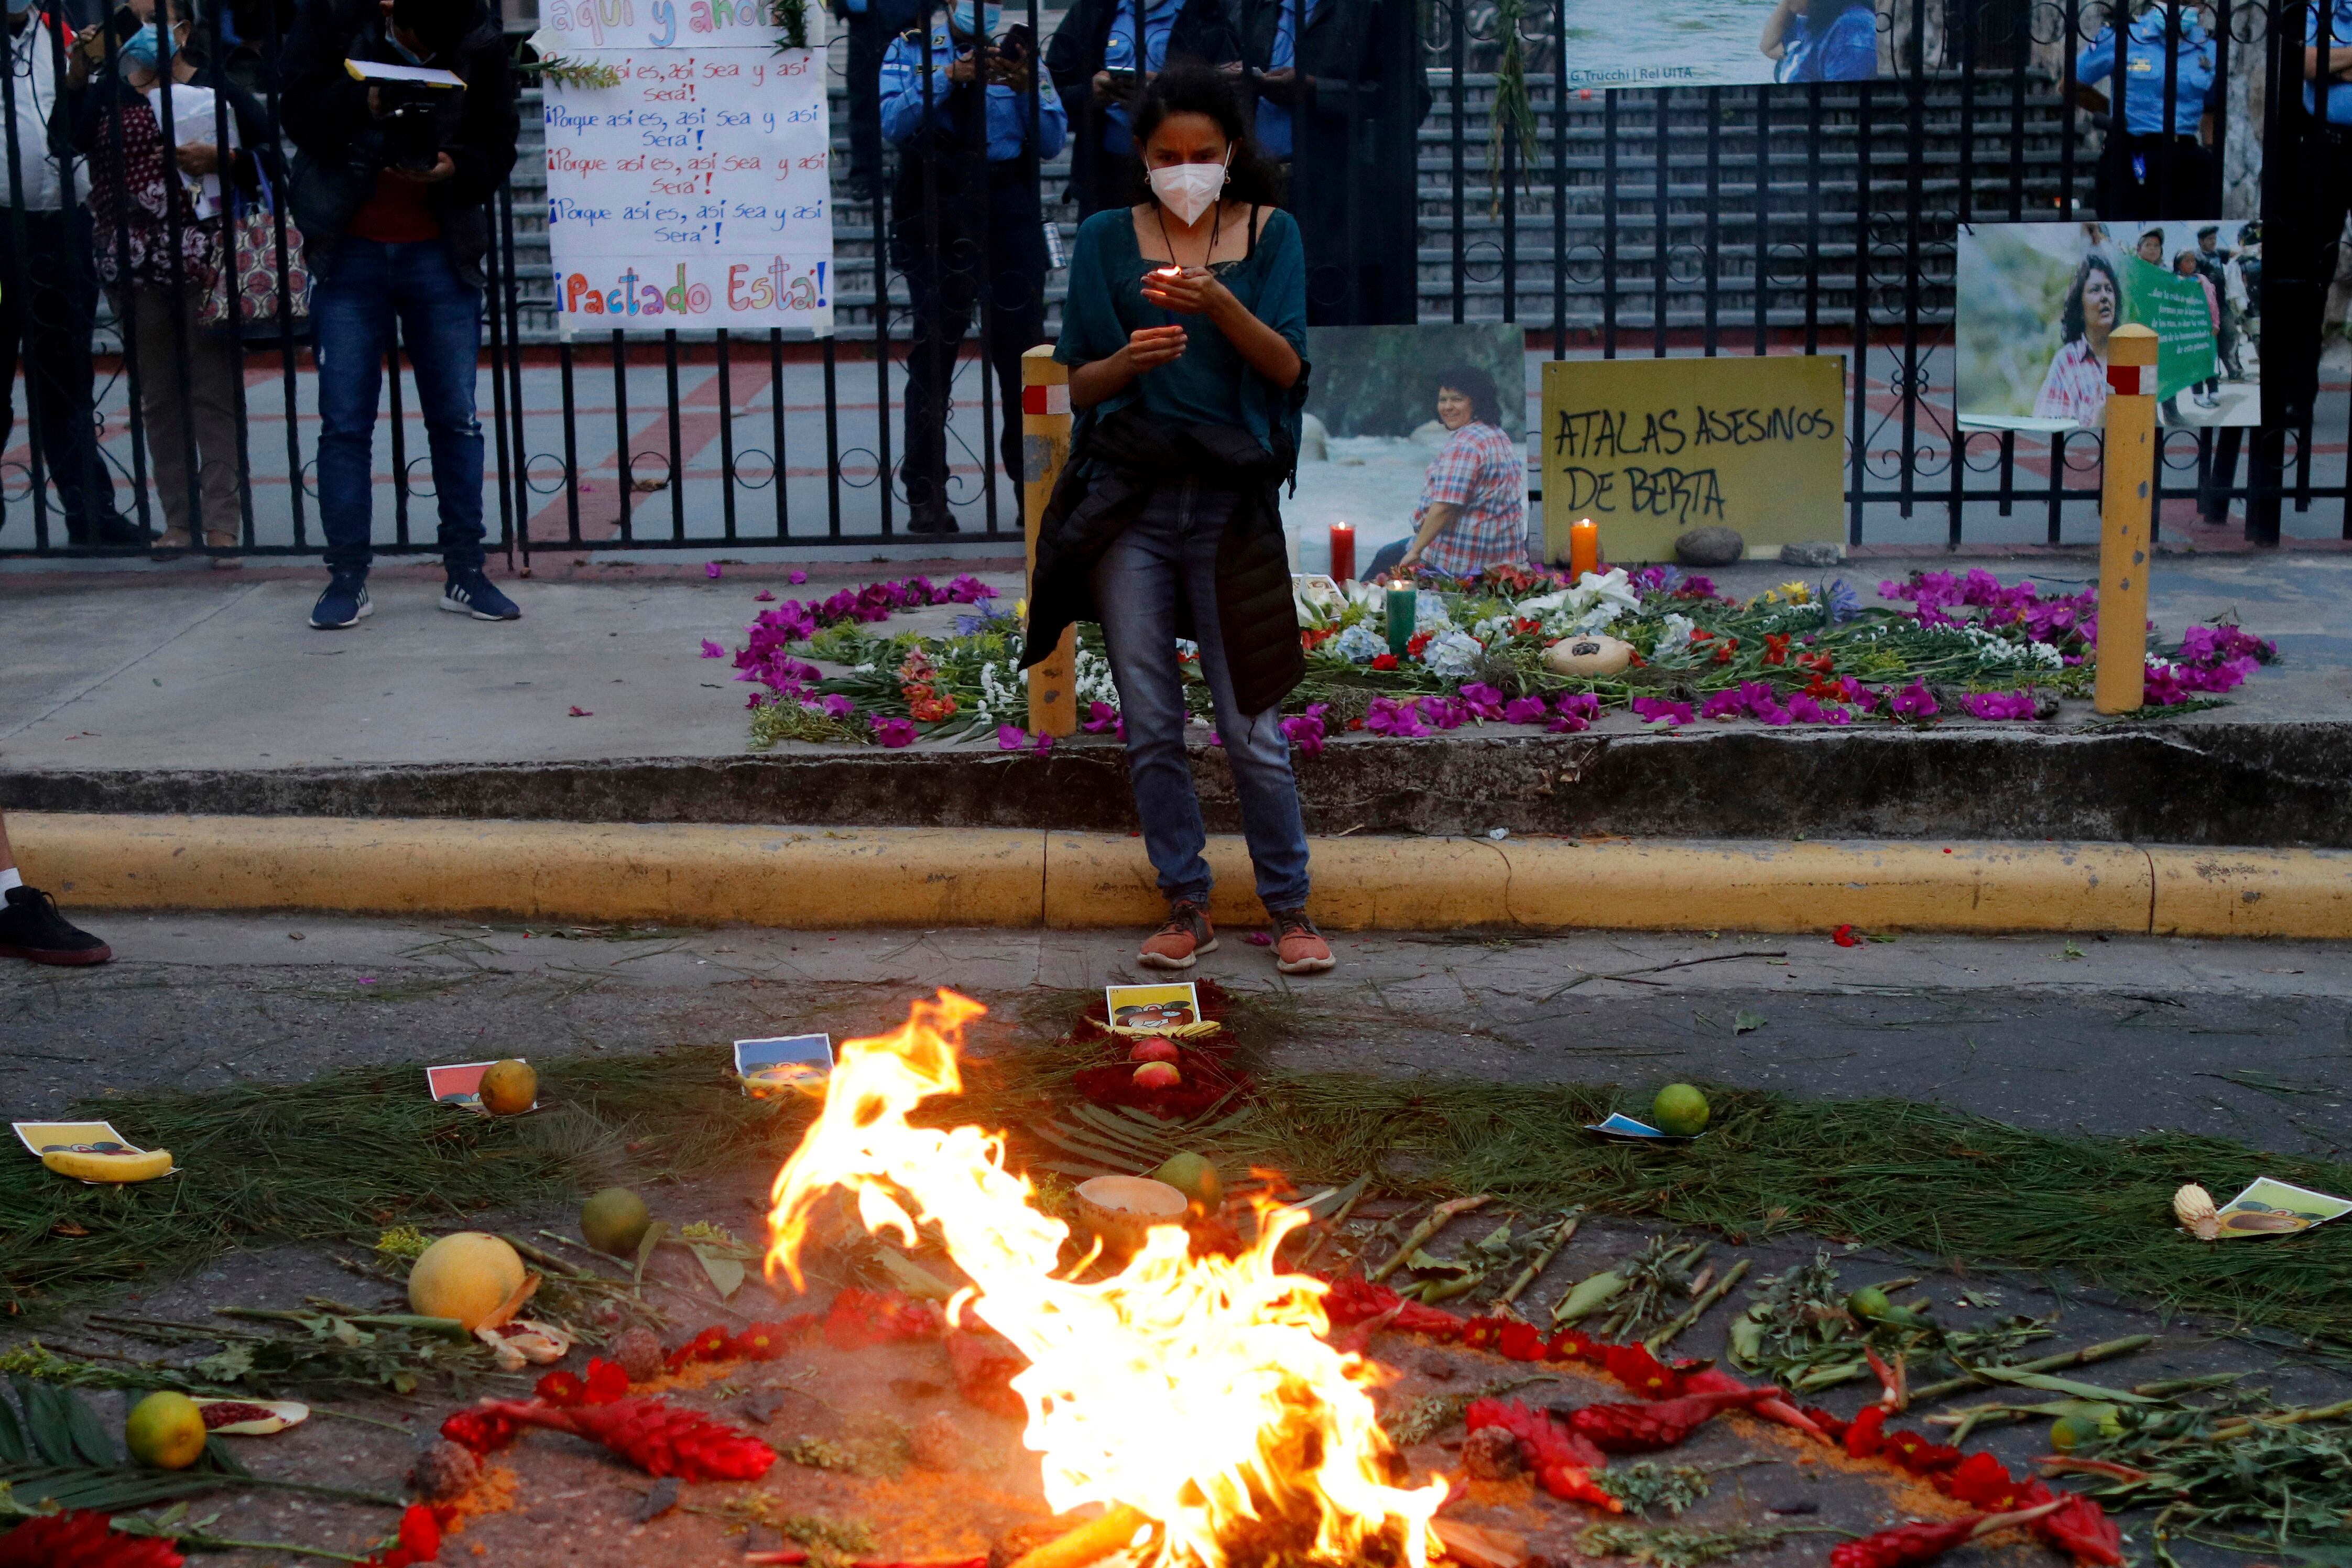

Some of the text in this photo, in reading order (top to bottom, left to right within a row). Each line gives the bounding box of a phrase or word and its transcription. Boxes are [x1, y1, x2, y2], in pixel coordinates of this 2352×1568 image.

[648, 0, 676, 47] y
[668, 58, 694, 79] así
[752, 64, 764, 87] y
[777, 56, 810, 76] así
[1640, 67, 1659, 79] Rel
[1663, 66, 1693, 78] UITA
[546, 105, 599, 136] ¡Porque
[606, 110, 634, 127] así
[638, 112, 668, 132] es,
[676, 107, 706, 125] así
[763, 112, 775, 134] y
[787, 104, 818, 123] así
[548, 147, 608, 179] ¡Porque
[617, 154, 646, 171] así
[650, 158, 681, 176] es,
[688, 153, 717, 170] así
[776, 159, 789, 180] y
[798, 153, 826, 169] así
[549, 198, 612, 226] ¡Porque
[623, 201, 650, 220] así
[655, 208, 687, 225] es,
[696, 200, 727, 219] así
[770, 208, 786, 232] y
[793, 200, 822, 219] así
[555, 255, 827, 316] ¡Pactado Está!
[1694, 405, 1835, 446] ASESINOS
[1563, 466, 1726, 524] DE BERTA
